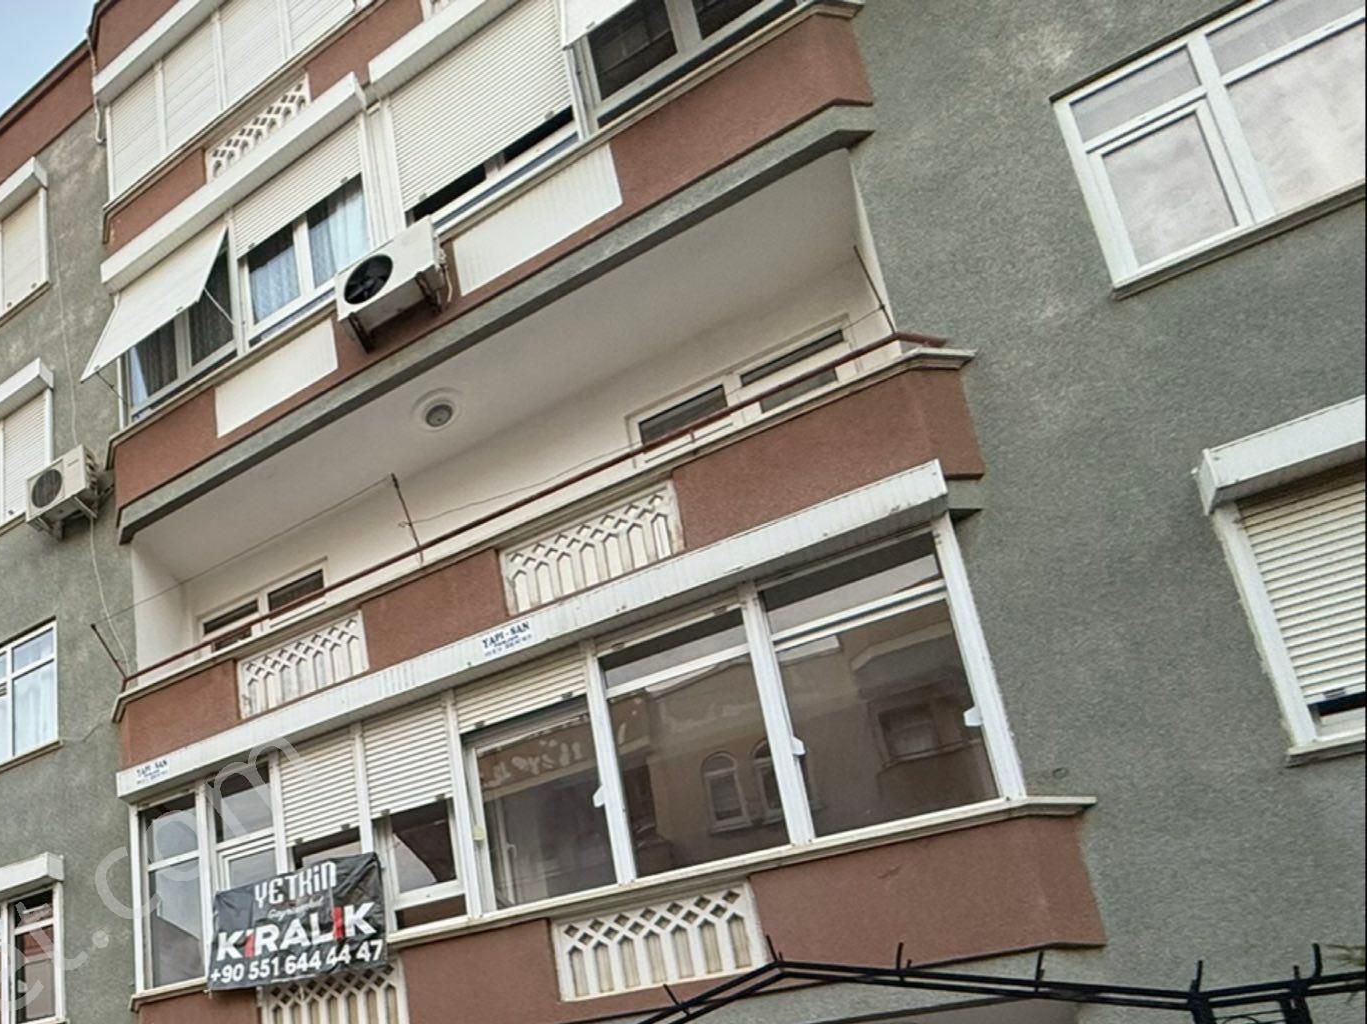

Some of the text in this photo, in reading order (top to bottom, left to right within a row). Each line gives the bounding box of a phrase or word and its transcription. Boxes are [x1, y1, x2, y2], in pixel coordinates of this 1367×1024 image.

[216, 901, 377, 962] KIRALIK
[210, 963, 245, 984] +90
[248, 956, 280, 981] 551
[284, 950, 322, 975] 644
[326, 943, 352, 967] 44
[356, 939, 384, 963] 47
